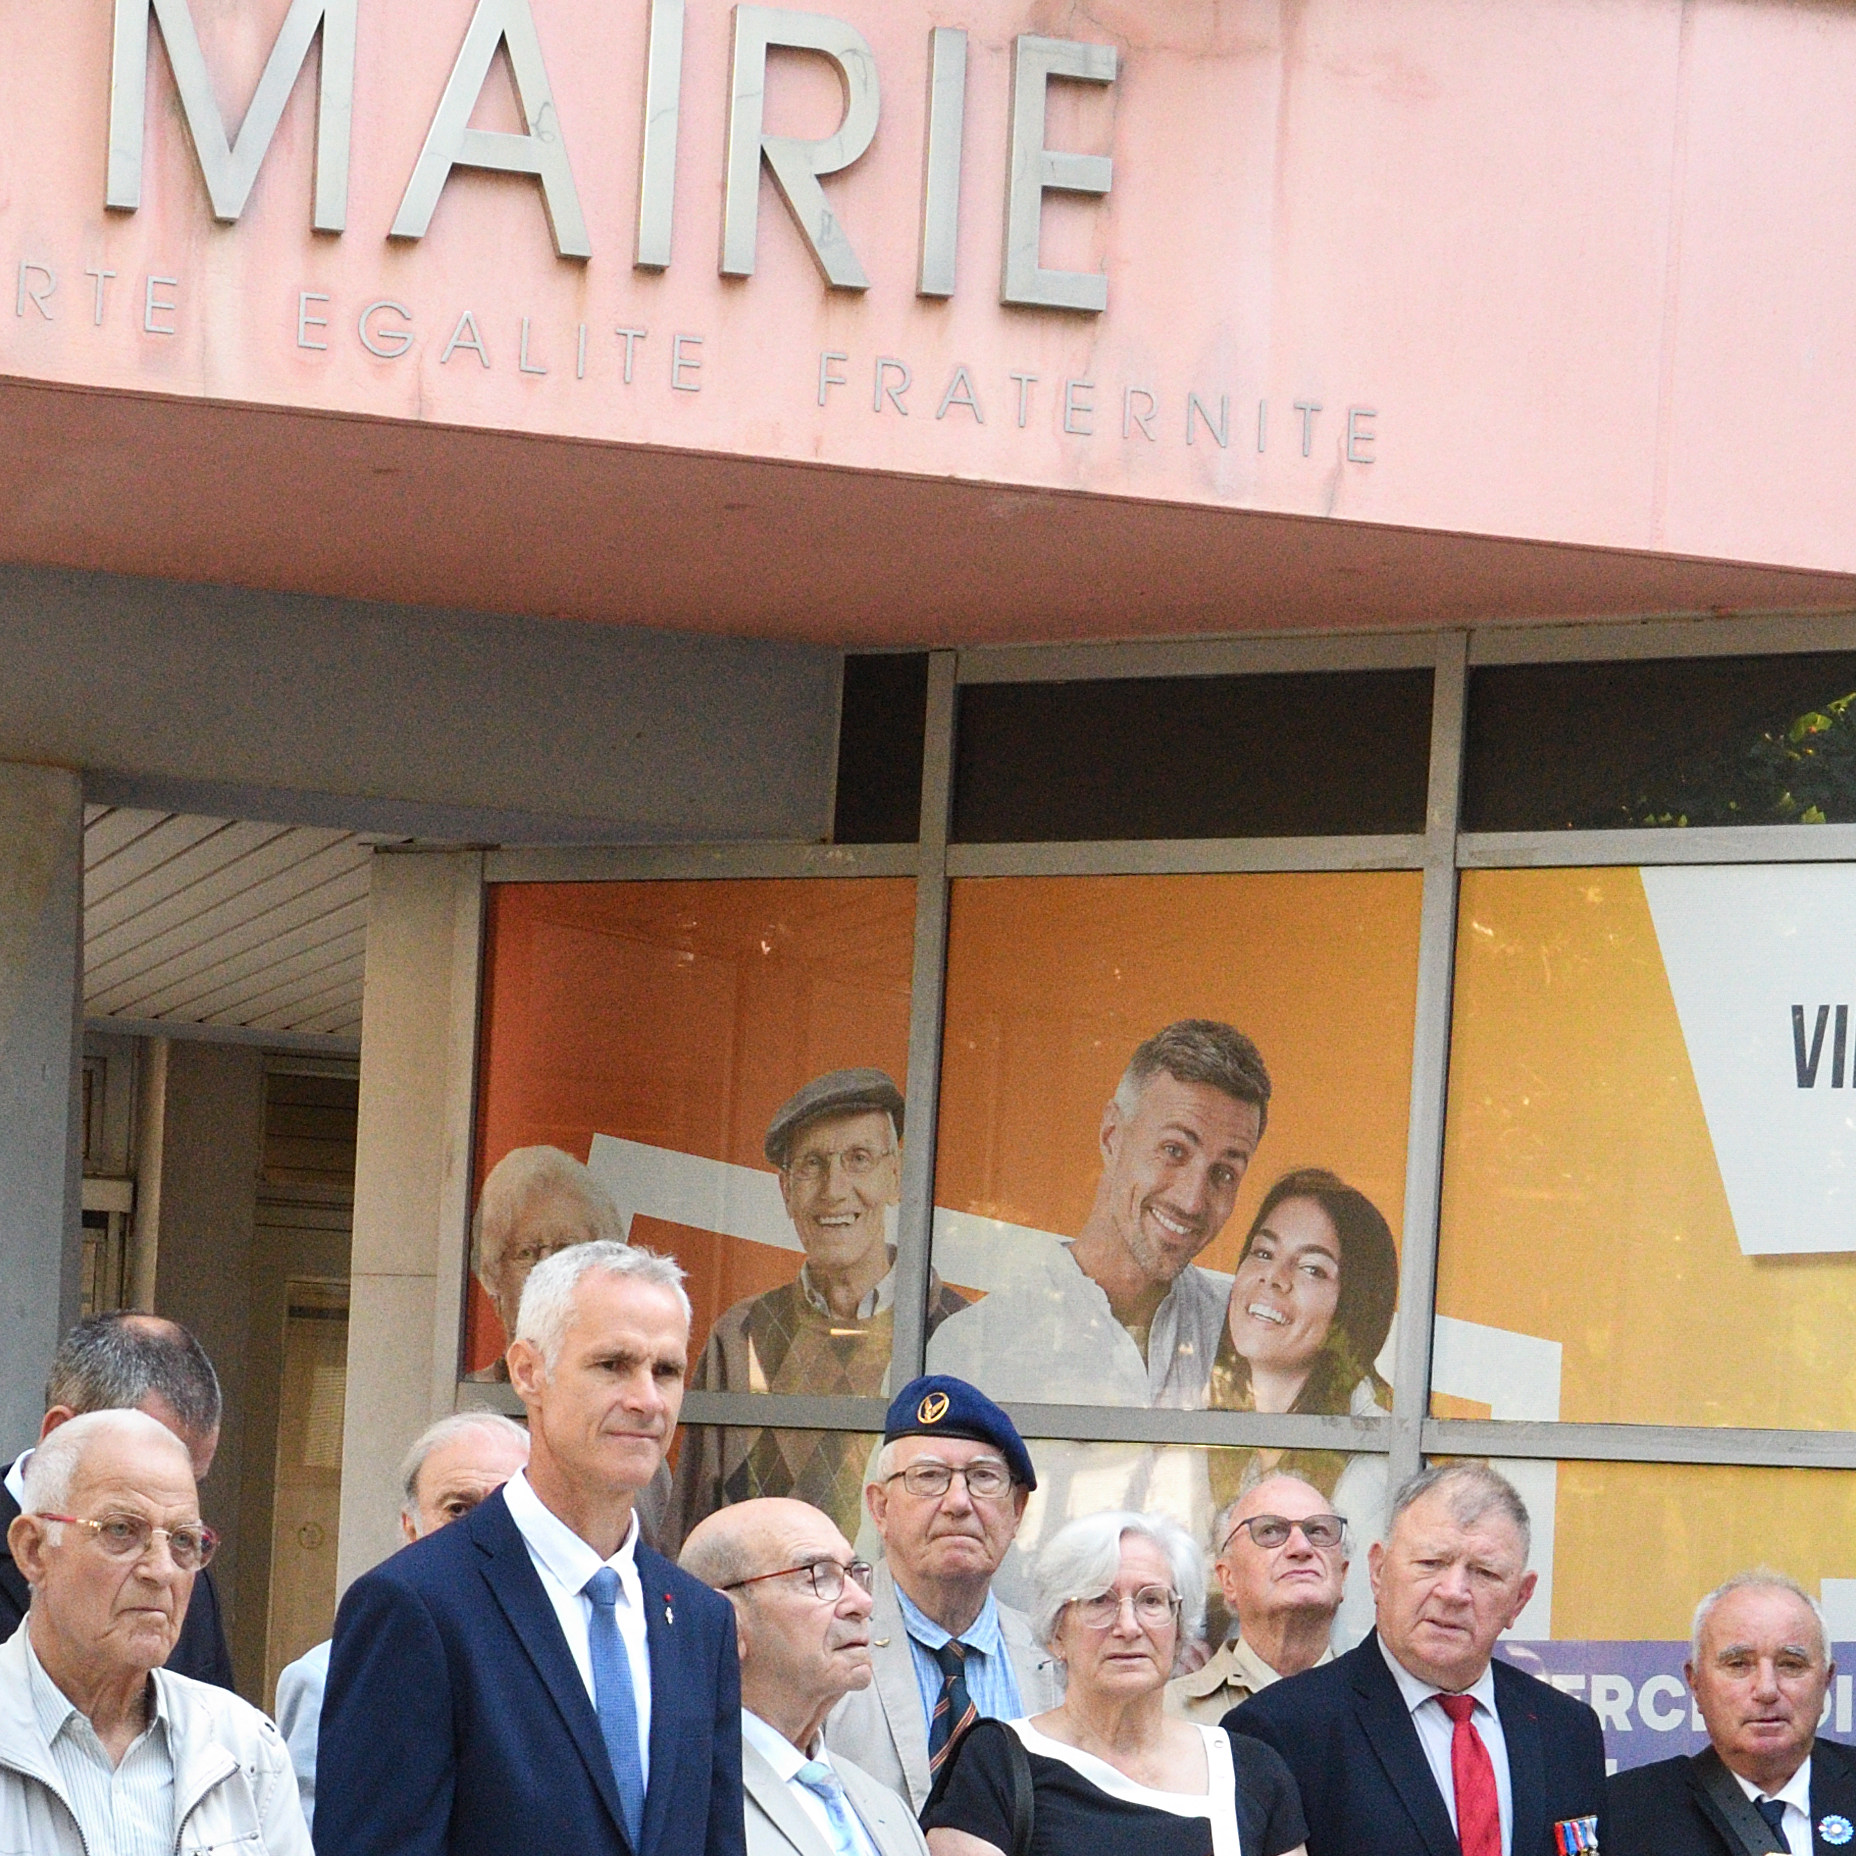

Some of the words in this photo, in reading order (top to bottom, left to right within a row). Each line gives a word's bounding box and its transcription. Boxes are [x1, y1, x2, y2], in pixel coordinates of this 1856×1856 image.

[104, 0, 1118, 314] MAIRIE
[296, 291, 704, 392] EGALITE
[817, 351, 1379, 464] FRATERNITE
